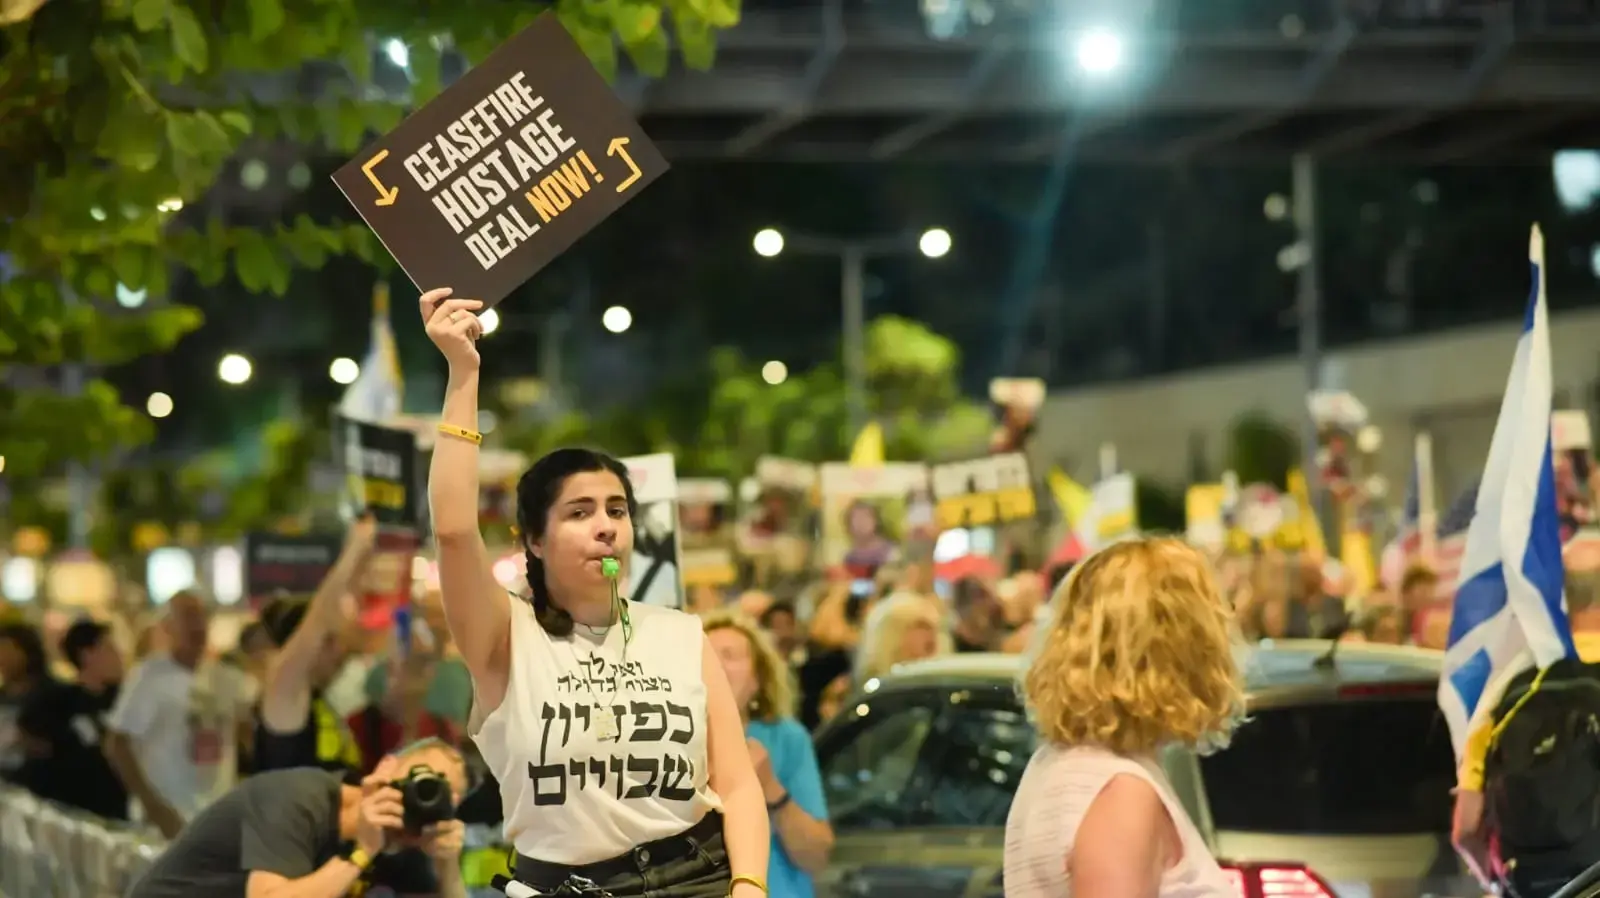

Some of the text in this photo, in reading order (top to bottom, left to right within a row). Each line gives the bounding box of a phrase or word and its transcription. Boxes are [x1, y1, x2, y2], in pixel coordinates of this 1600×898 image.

[403, 71, 545, 193] CEASEFIRE
[431, 108, 576, 234] HOSTAGE
[464, 149, 604, 271] DEAL NOW!
[557, 670, 617, 693] גדולה
[577, 650, 605, 681] לך
[528, 753, 696, 806] שבויים
